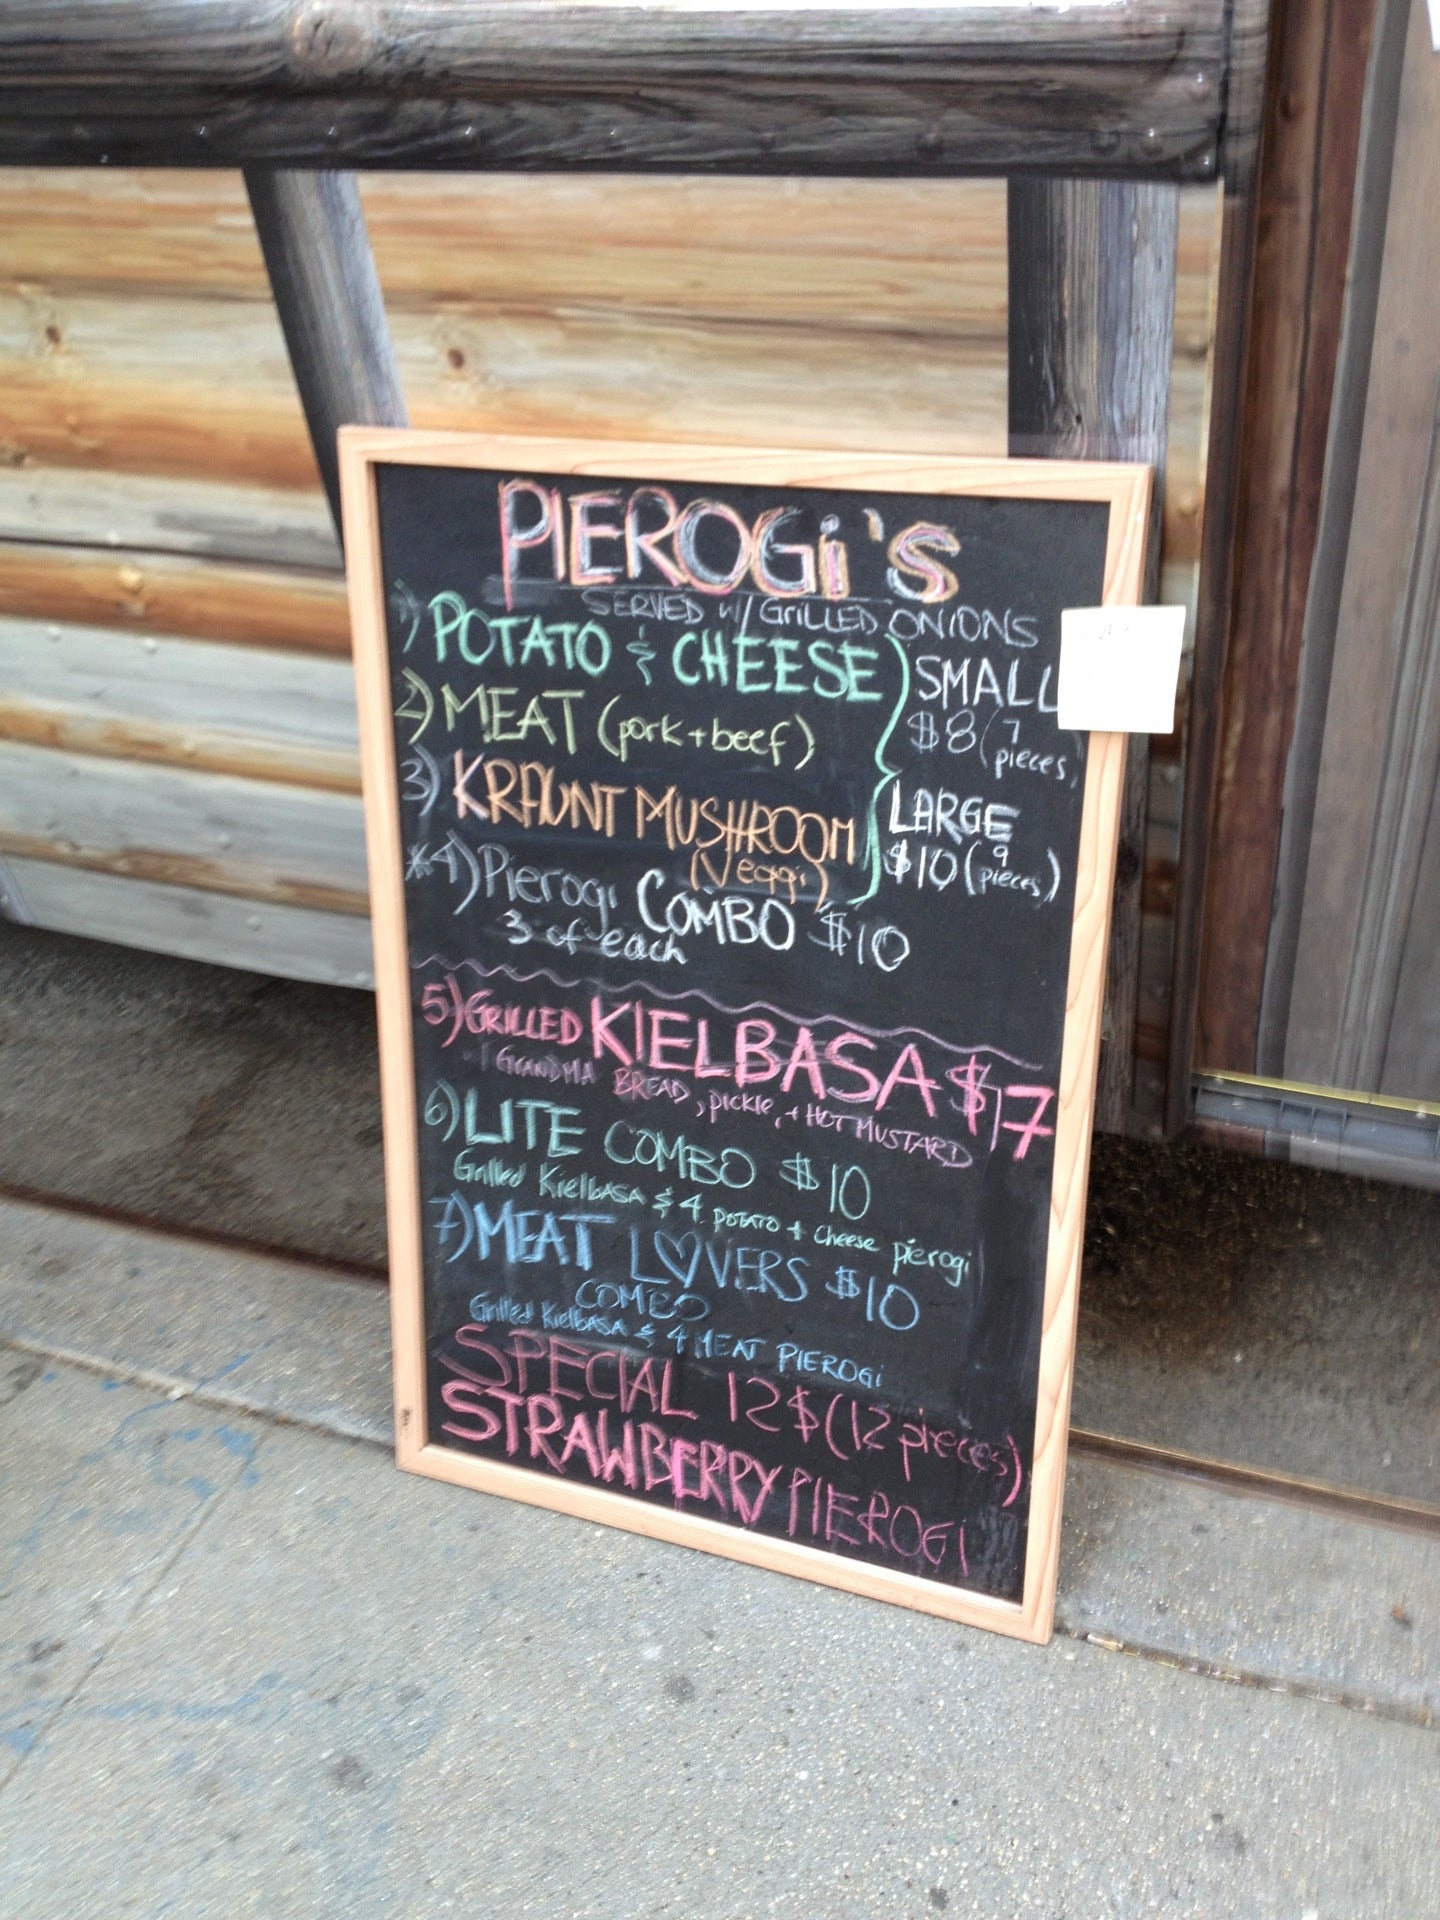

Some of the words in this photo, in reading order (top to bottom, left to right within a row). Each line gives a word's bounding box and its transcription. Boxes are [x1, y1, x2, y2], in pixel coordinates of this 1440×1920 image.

[426, 590, 612, 677] POTATO
[671, 628, 883, 702] CHEESE
[915, 655, 1059, 713] SMALL
[440, 683, 586, 755] MEAT
[635, 784, 857, 868] MUSHROOM
[888, 778, 1022, 846] LARGE
[600, 926, 686, 965] each
[808, 908, 911, 972] $10
[590, 995, 943, 1119] KIELBASA
[463, 1086, 588, 1158] LITE
[603, 1119, 757, 1189] COMBO
[778, 1151, 871, 1221] $10
[472, 1198, 617, 1272] MEAT
[825, 1265, 921, 1331] $10
[430, 1323, 700, 1421] SPECIAL
[440, 1379, 785, 1526] STRAWBERRY
